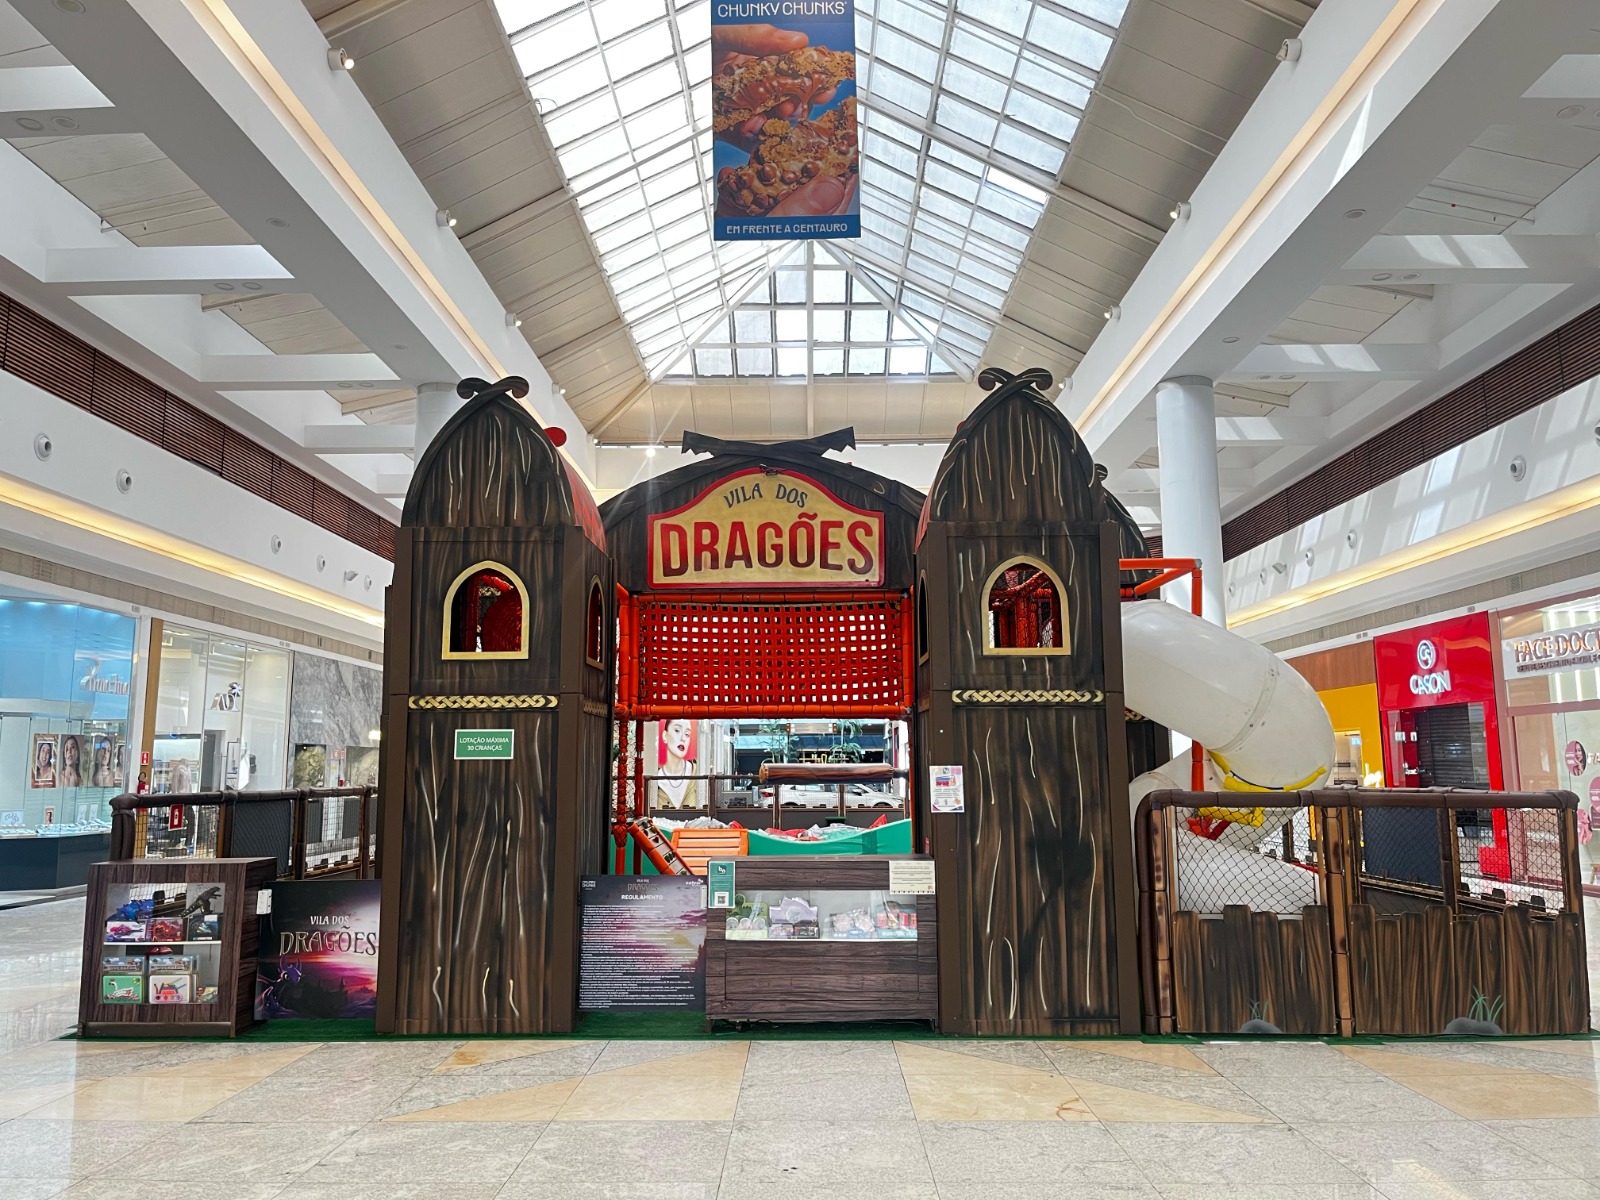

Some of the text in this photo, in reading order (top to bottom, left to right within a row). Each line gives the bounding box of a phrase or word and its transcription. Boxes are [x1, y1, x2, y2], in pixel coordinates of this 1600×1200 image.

[726, 223, 848, 234] EM FRENTE A CENTAURO
[723, 482, 808, 508] VILA DOS
[660, 512, 874, 577] DRAGÕES
[1513, 635, 1555, 663] FACE
[1409, 669, 1452, 695] CASON
[310, 915, 350, 926] VILA DOS
[279, 925, 379, 956] DRAGÕES
